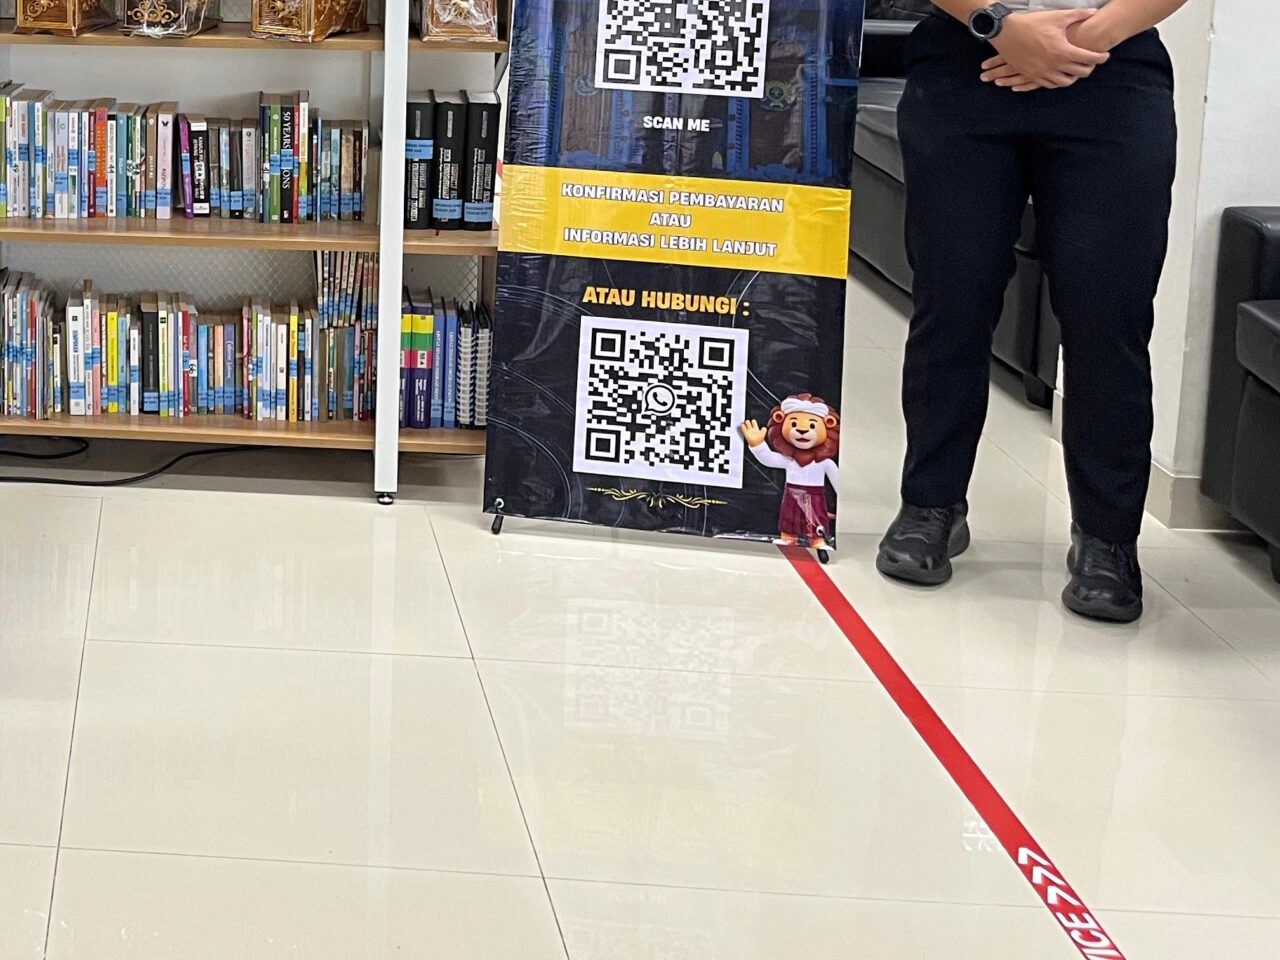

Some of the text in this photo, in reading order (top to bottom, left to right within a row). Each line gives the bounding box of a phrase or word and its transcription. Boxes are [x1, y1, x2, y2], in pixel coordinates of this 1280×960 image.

[282, 123, 291, 149] YEARS
[643, 116, 710, 132] SCAN ME
[561, 183, 784, 213] KONFIRMASI PEMBAYARAN
[650, 212, 692, 228] ATAU
[563, 228, 777, 257] INFORMASI LEBIH LANJUT
[582, 285, 636, 307] ATAU
[641, 290, 737, 314] HUBUNGI
